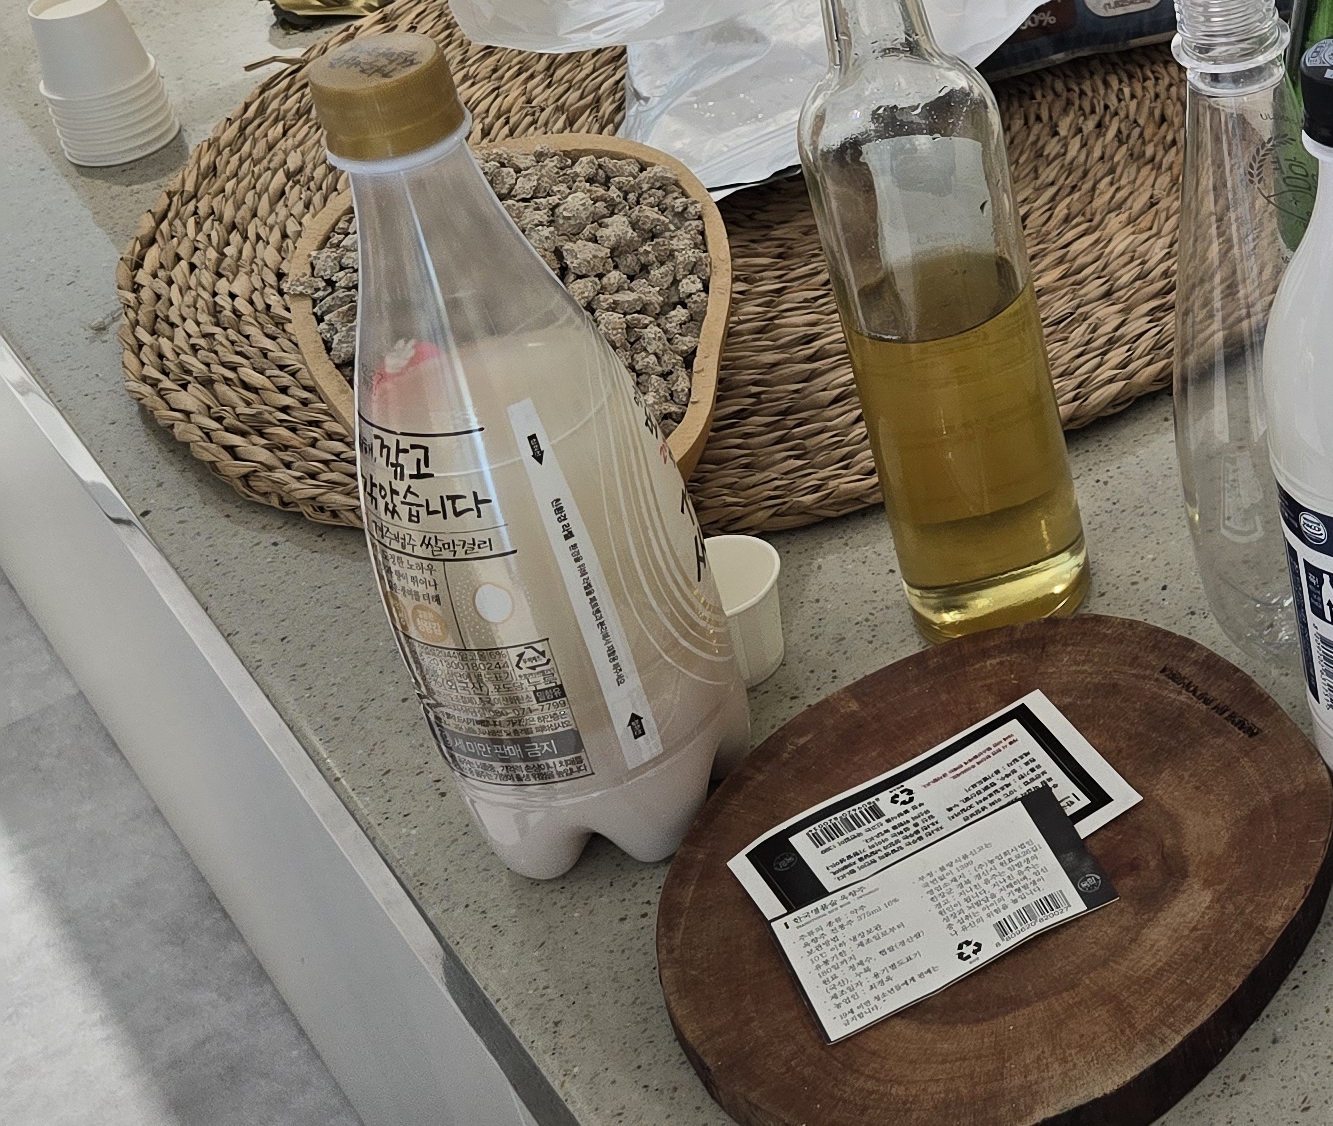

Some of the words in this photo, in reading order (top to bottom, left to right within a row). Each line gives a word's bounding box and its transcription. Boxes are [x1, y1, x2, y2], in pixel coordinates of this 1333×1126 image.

[419, 534, 494, 558] 쌀막걸리
[466, 741, 492, 757] 미만
[493, 744, 524, 759] 판매
[524, 740, 558, 758] 금지
